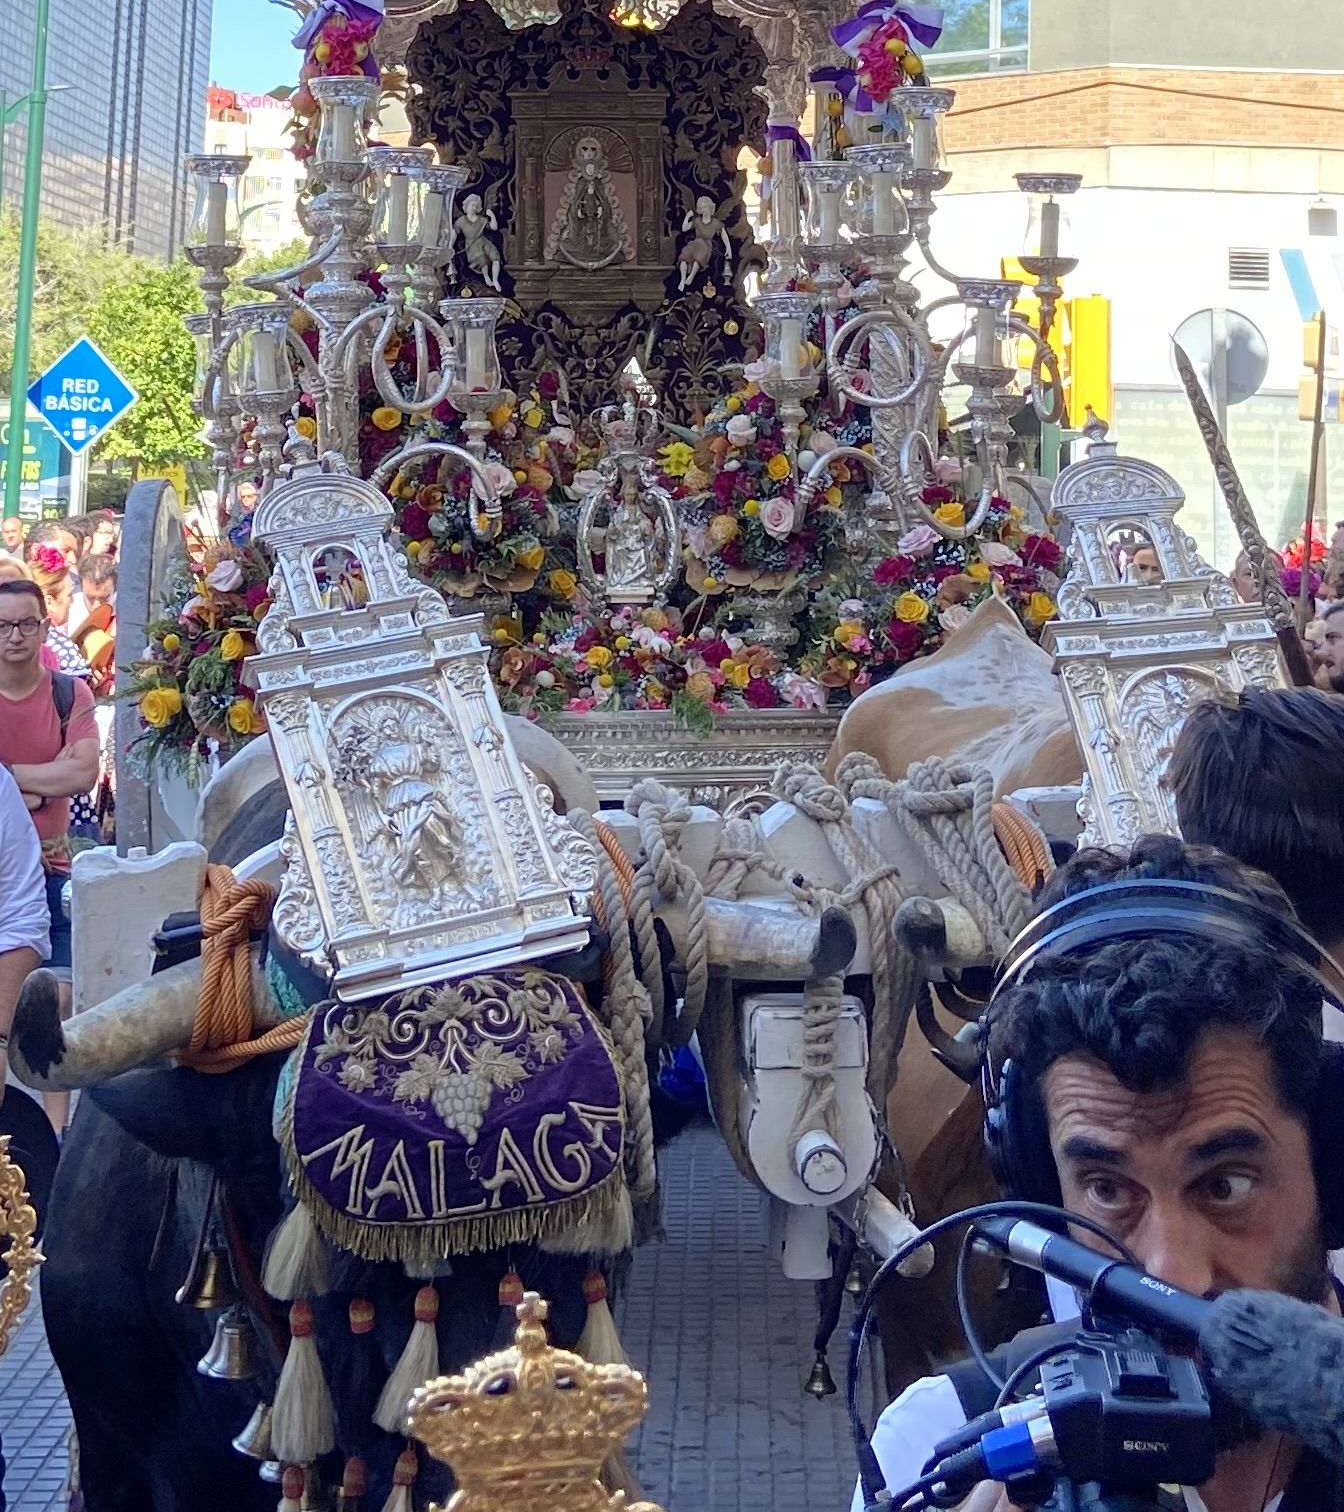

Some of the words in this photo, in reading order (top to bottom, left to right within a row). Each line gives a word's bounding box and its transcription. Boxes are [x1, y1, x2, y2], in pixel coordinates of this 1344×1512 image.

[62, 378, 99, 394] RED
[45, 393, 113, 413] BÁSICA
[301, 1100, 625, 1220] MALAGA
[1139, 1276, 1177, 1296] SONY
[1123, 1439, 1169, 1452] SONY
